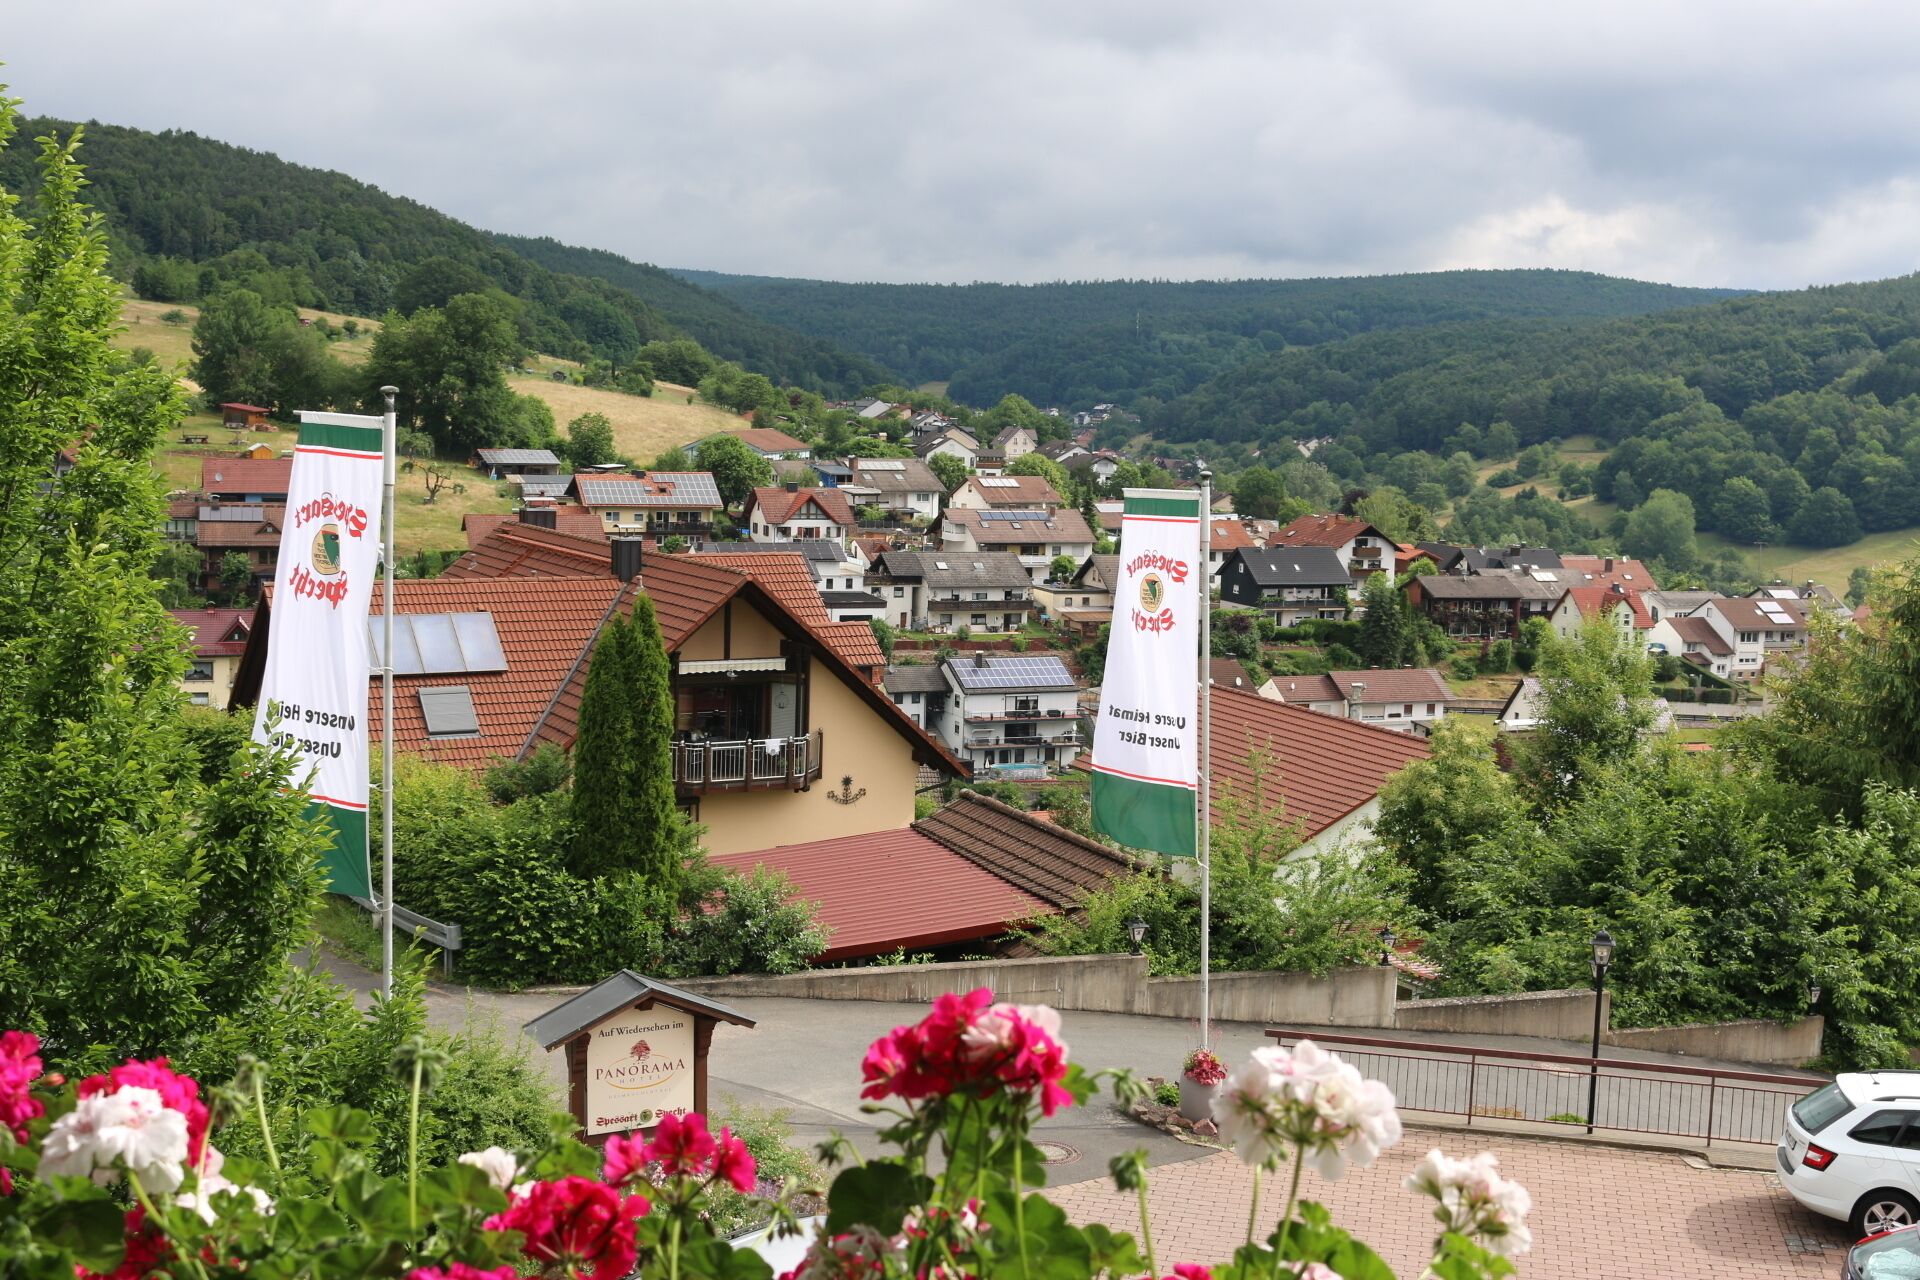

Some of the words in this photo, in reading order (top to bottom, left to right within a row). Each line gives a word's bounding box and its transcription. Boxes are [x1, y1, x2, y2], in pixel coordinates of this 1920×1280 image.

[598, 1028, 615, 1038] Auf
[616, 1022, 670, 1036] Wiedersehen
[672, 1021, 684, 1029] im
[596, 1058, 685, 1080] PANORAMA
[619, 1074, 661, 1085] HOTEL
[596, 1112, 638, 1127] Spessart
